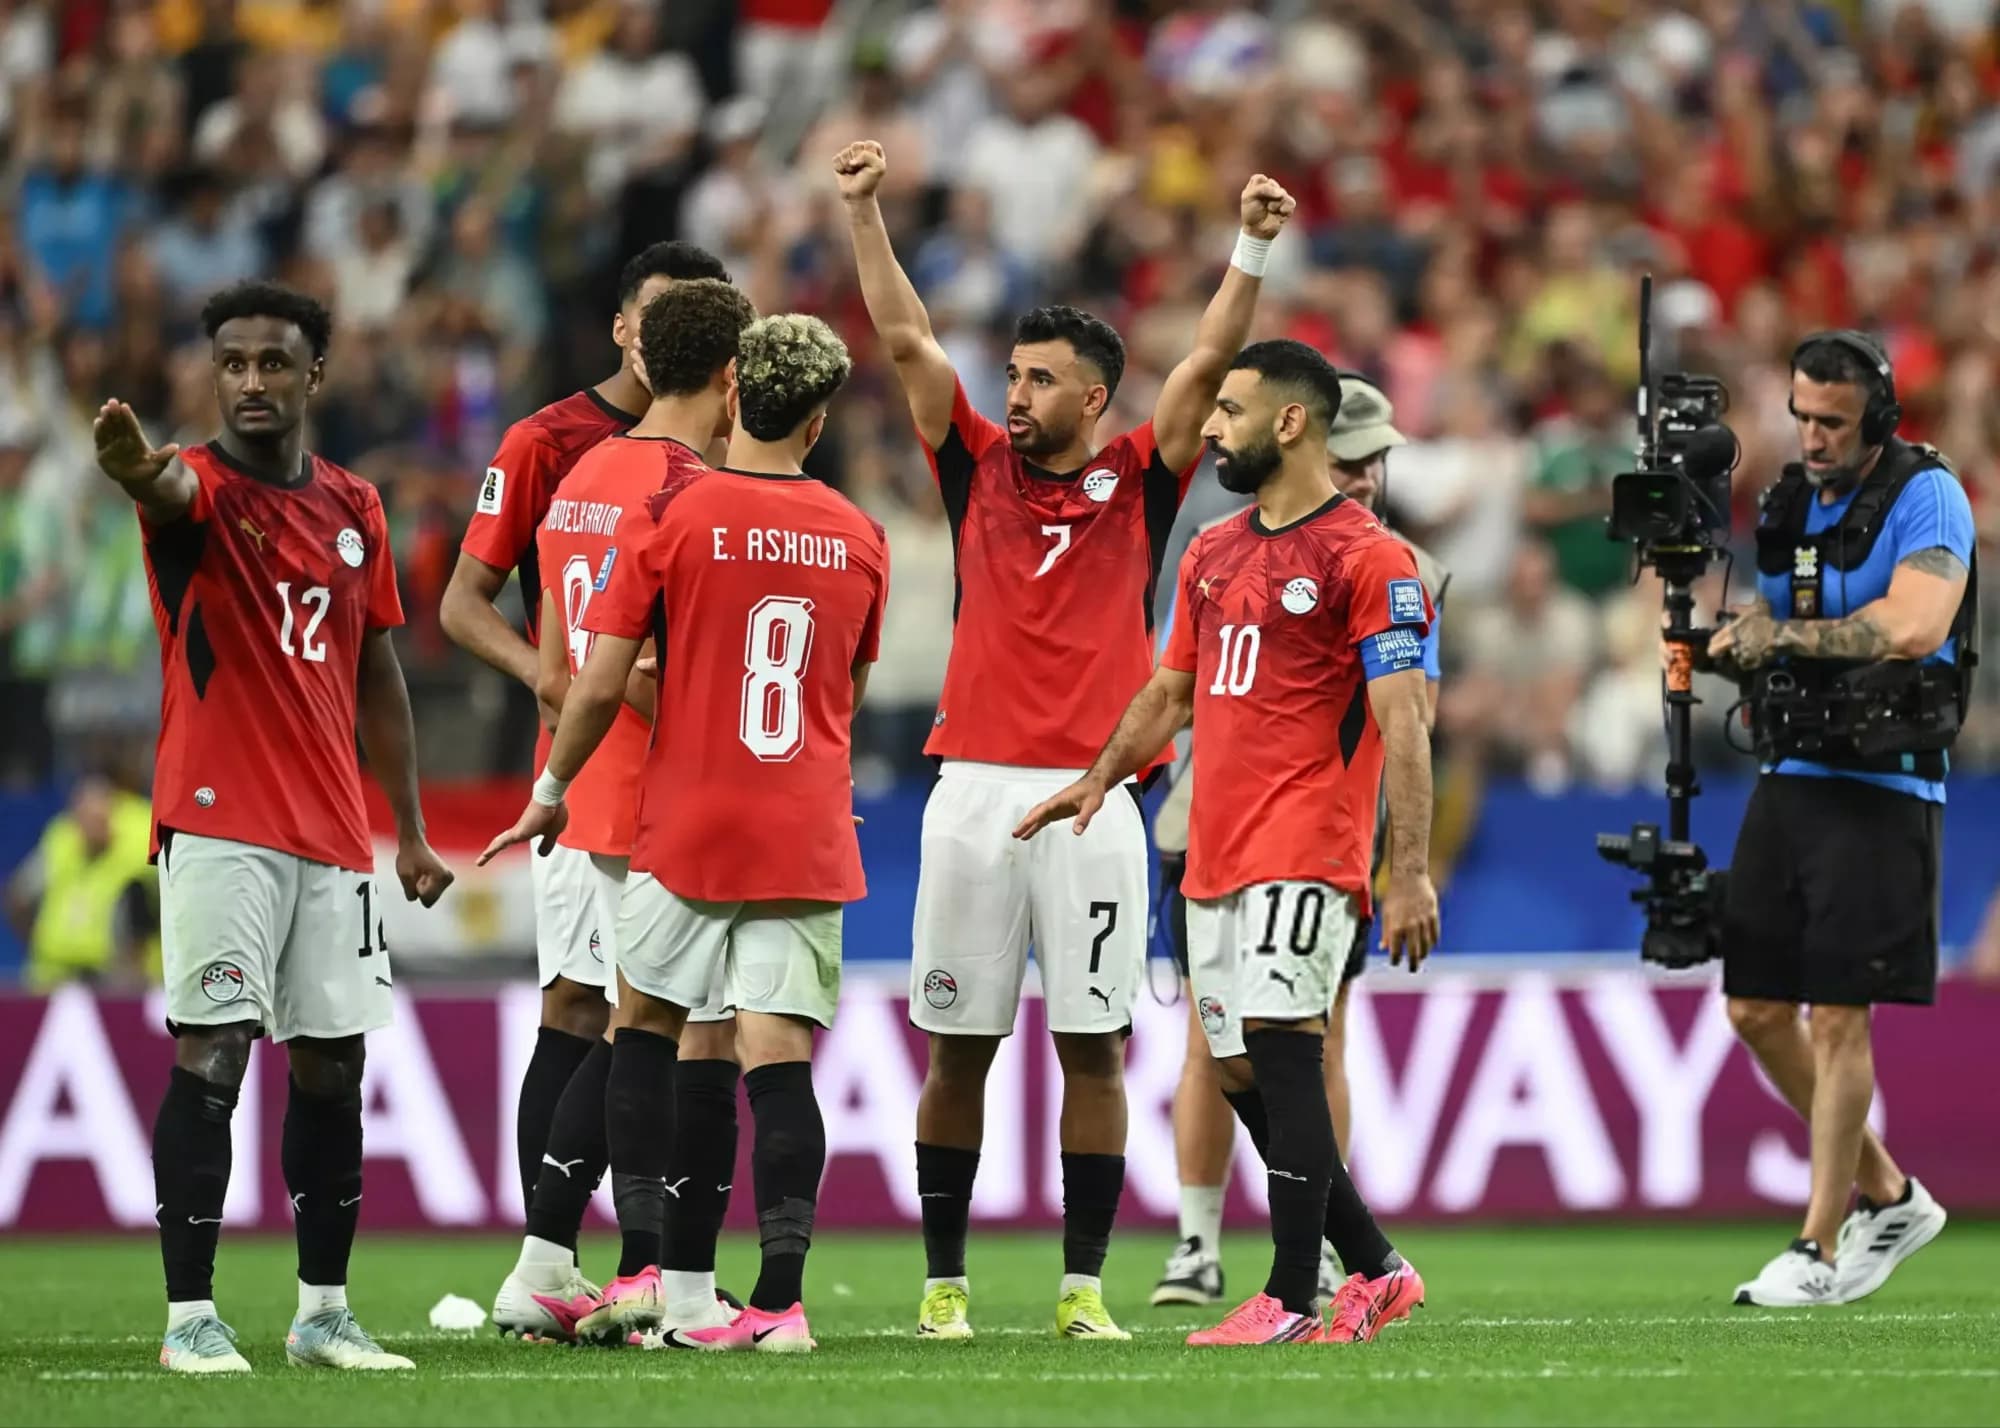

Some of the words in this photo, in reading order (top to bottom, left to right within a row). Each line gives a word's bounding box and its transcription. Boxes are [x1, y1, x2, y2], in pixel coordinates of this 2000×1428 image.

[712, 527, 736, 561] E.
[747, 528, 848, 571] ASHOUR
[1033, 525, 1072, 577] 7
[276, 582, 331, 662] 12
[739, 595, 815, 762] 8
[1209, 625, 1261, 696] 10
[1089, 901, 1119, 973] 7
[1256, 884, 1324, 957] 10
